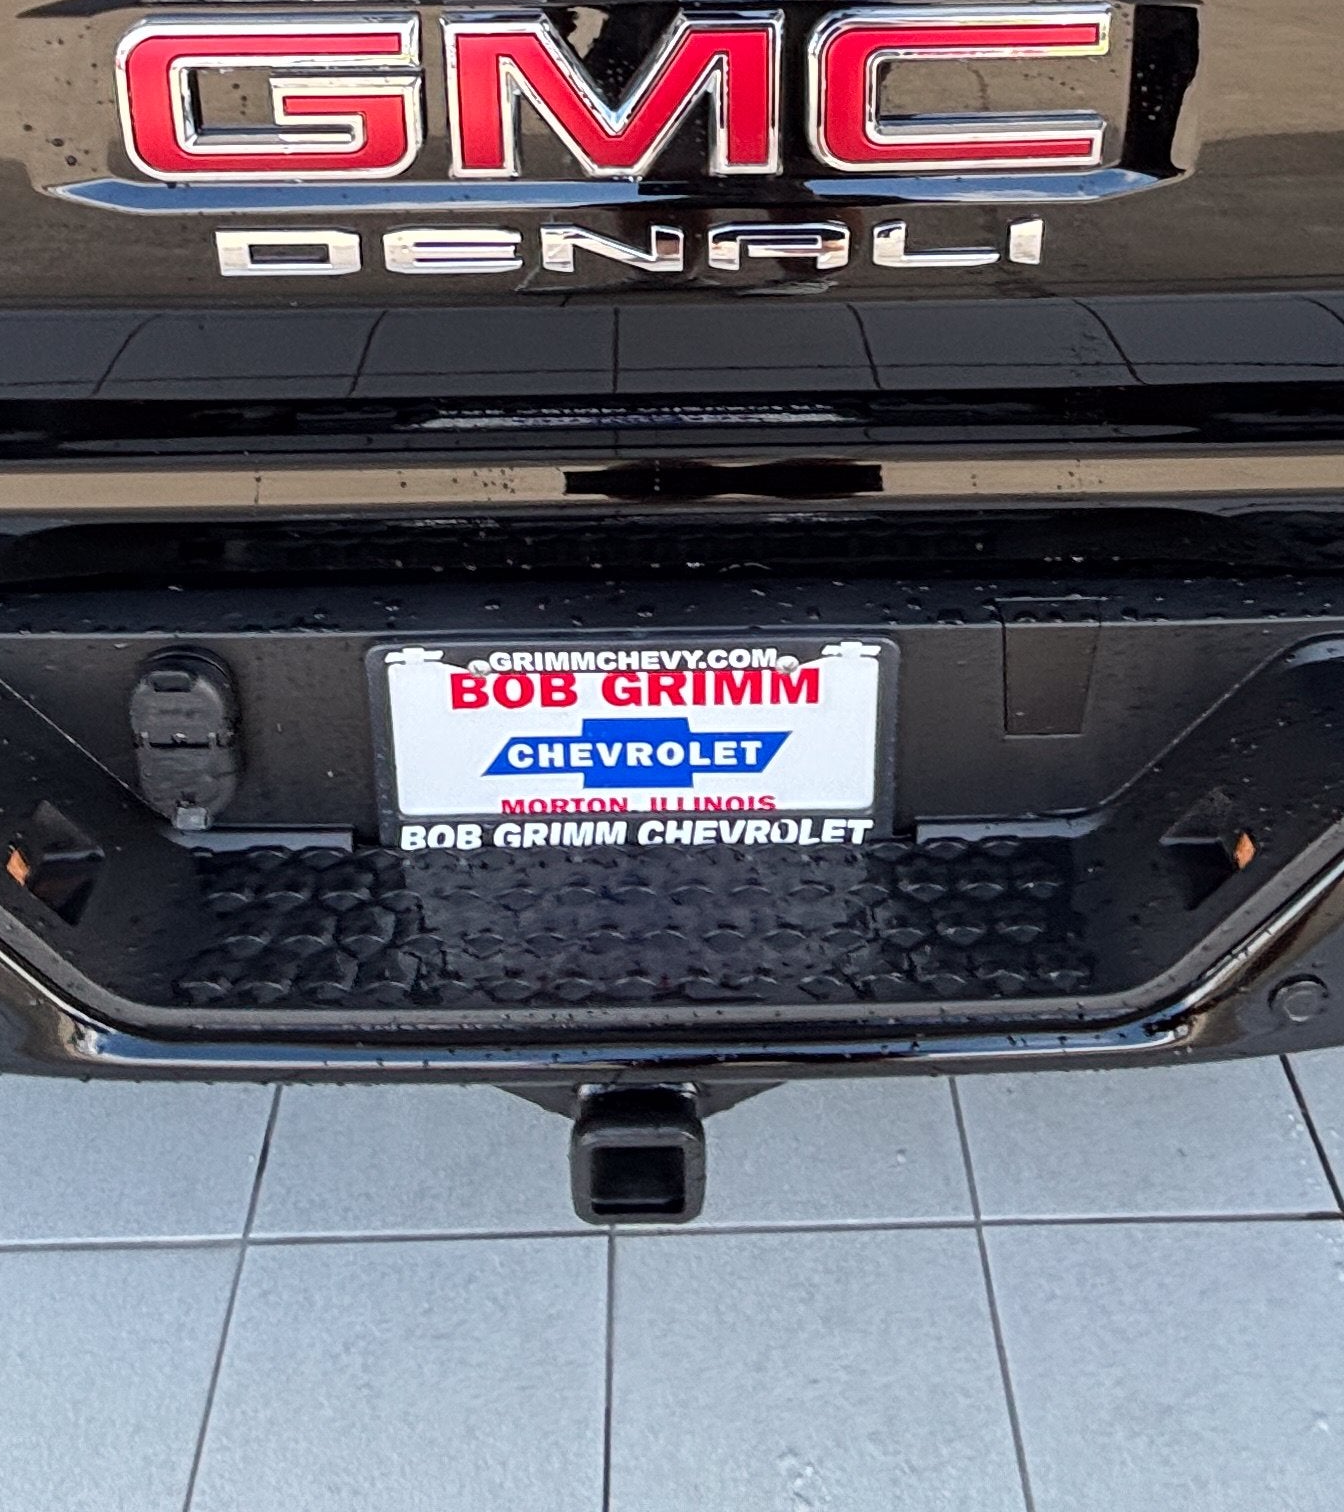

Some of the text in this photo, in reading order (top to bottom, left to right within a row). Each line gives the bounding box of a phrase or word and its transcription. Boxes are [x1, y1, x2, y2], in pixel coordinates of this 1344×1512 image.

[115, 7, 1112, 182] GMC
[214, 218, 1043, 277] DENALI
[488, 647, 778, 672] GRIMMCHEVY.COM
[450, 667, 821, 710] BOB GRIMM
[507, 740, 763, 769] CHEVROLET
[400, 818, 874, 852] BOB GRIMM CHEVROLET
